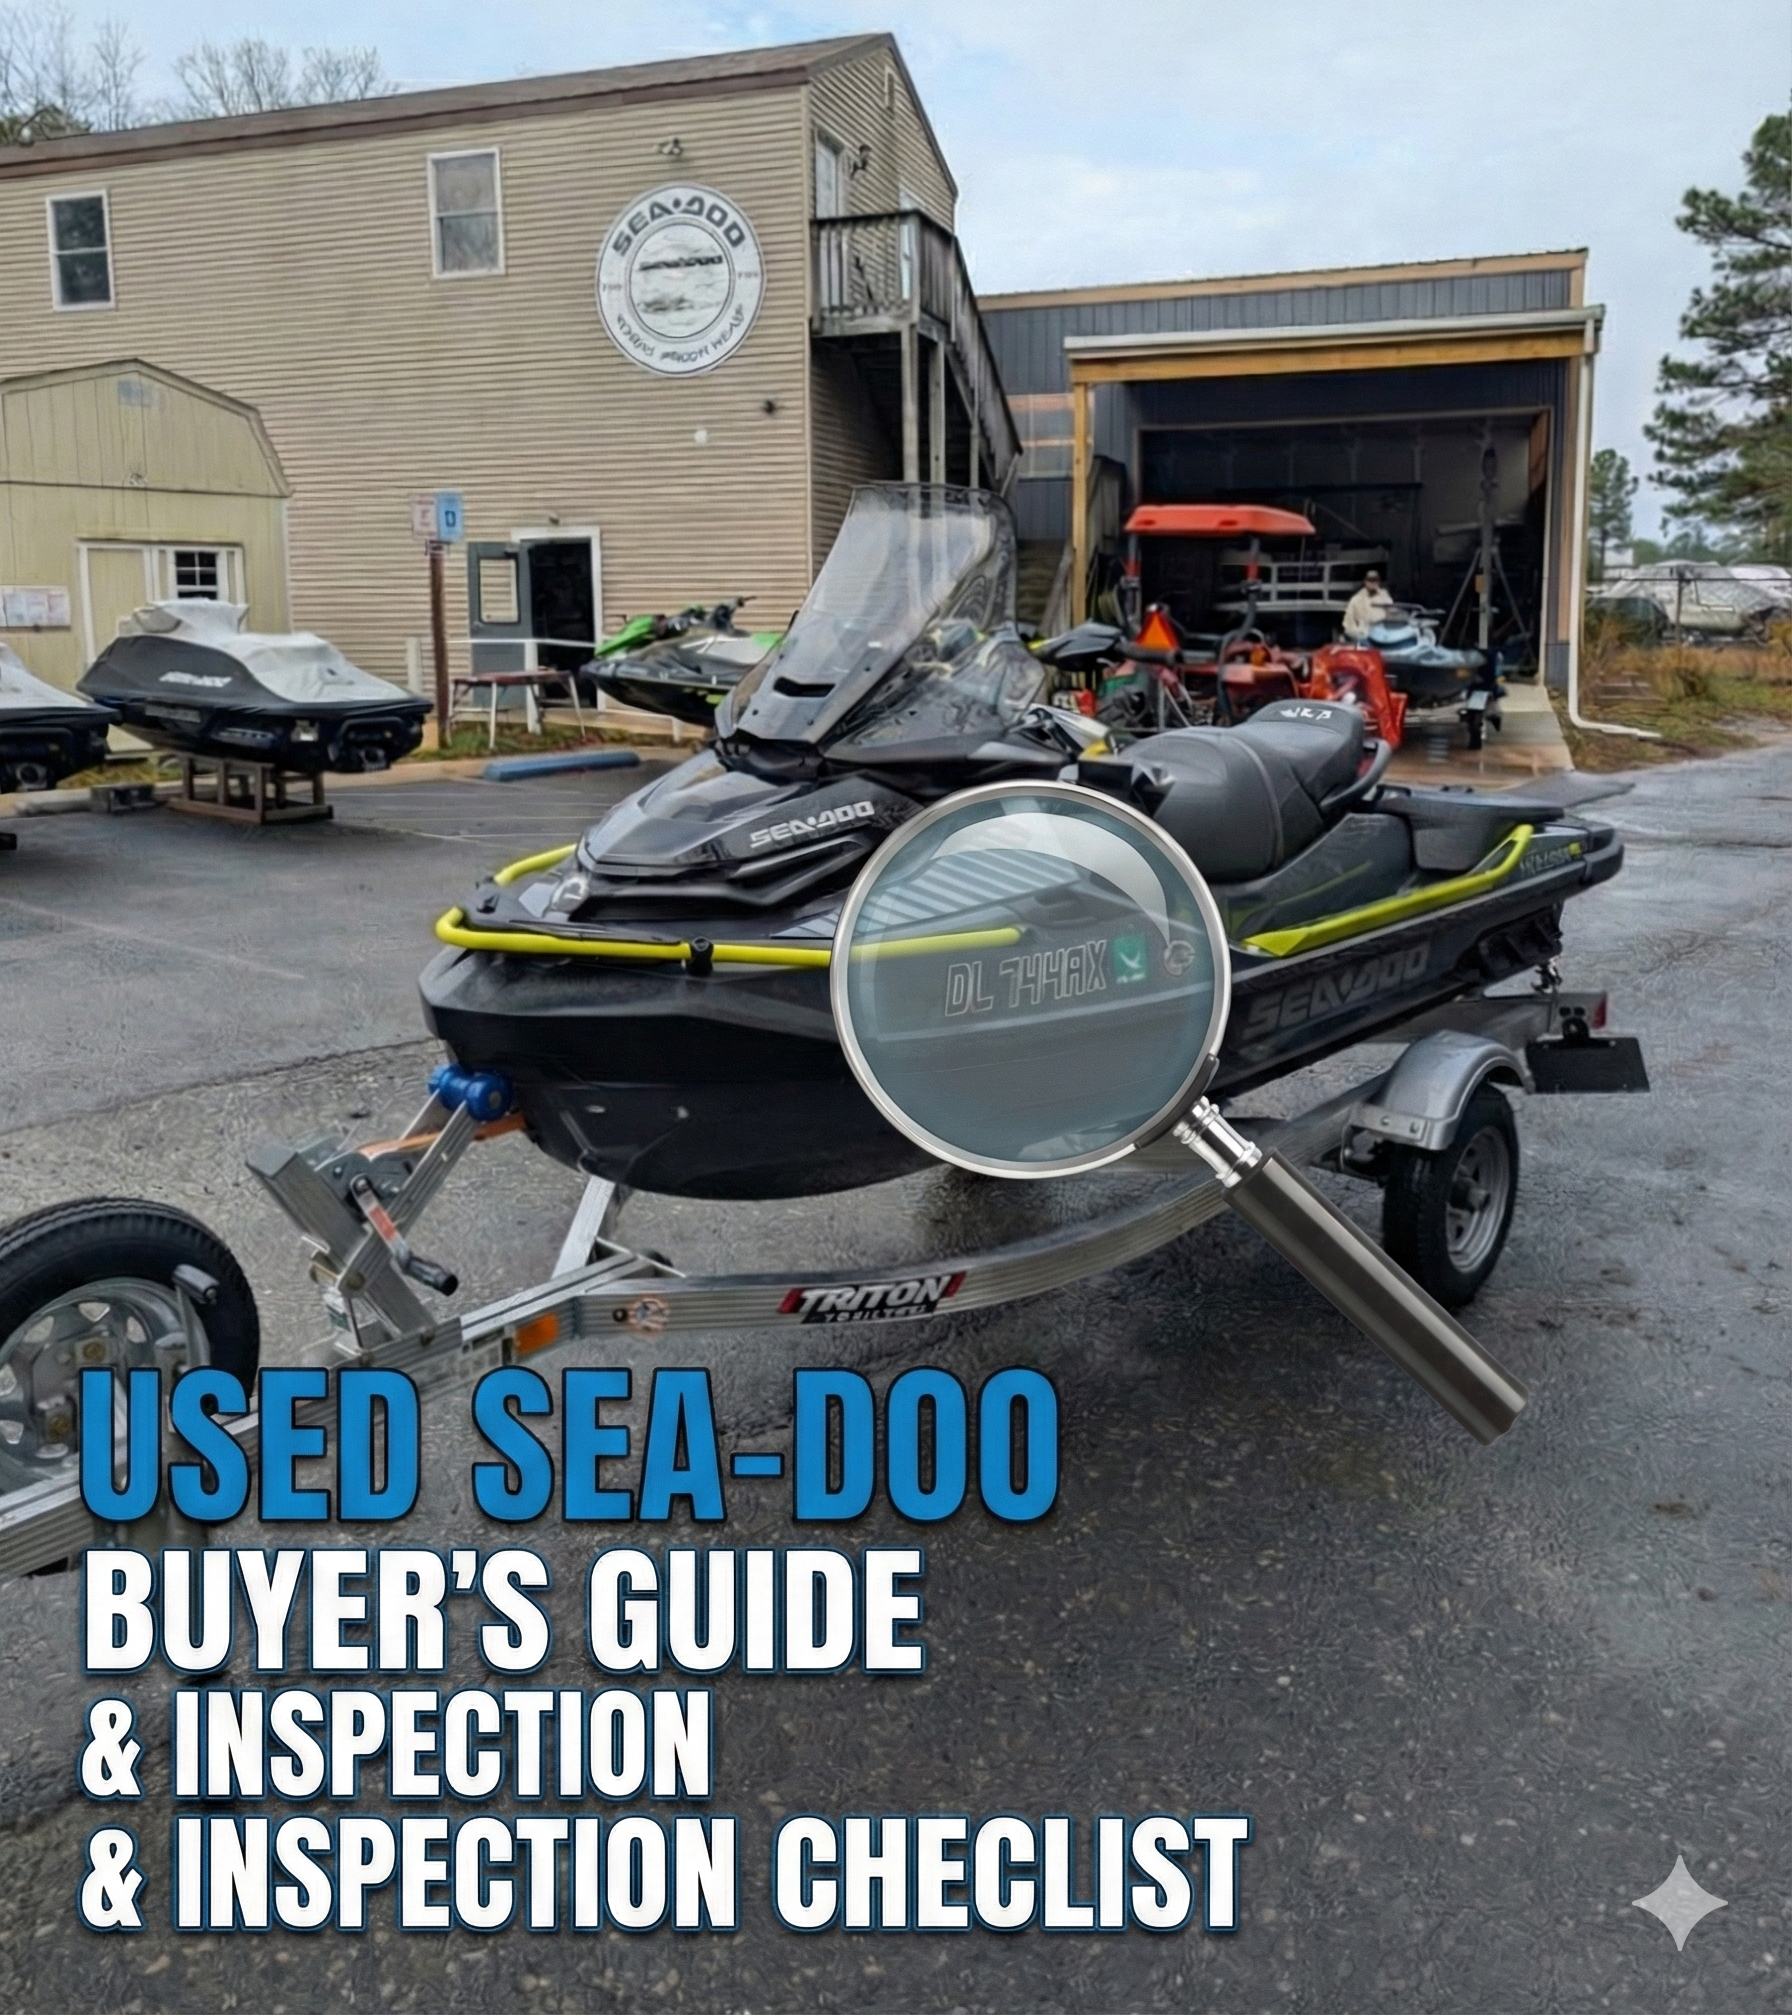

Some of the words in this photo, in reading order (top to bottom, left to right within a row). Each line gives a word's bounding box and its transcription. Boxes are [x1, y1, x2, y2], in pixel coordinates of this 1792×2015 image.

[945, 960, 994, 1017] DL
[1000, 939, 1108, 1009] 744AX
[799, 1275, 951, 1313] TRITON
